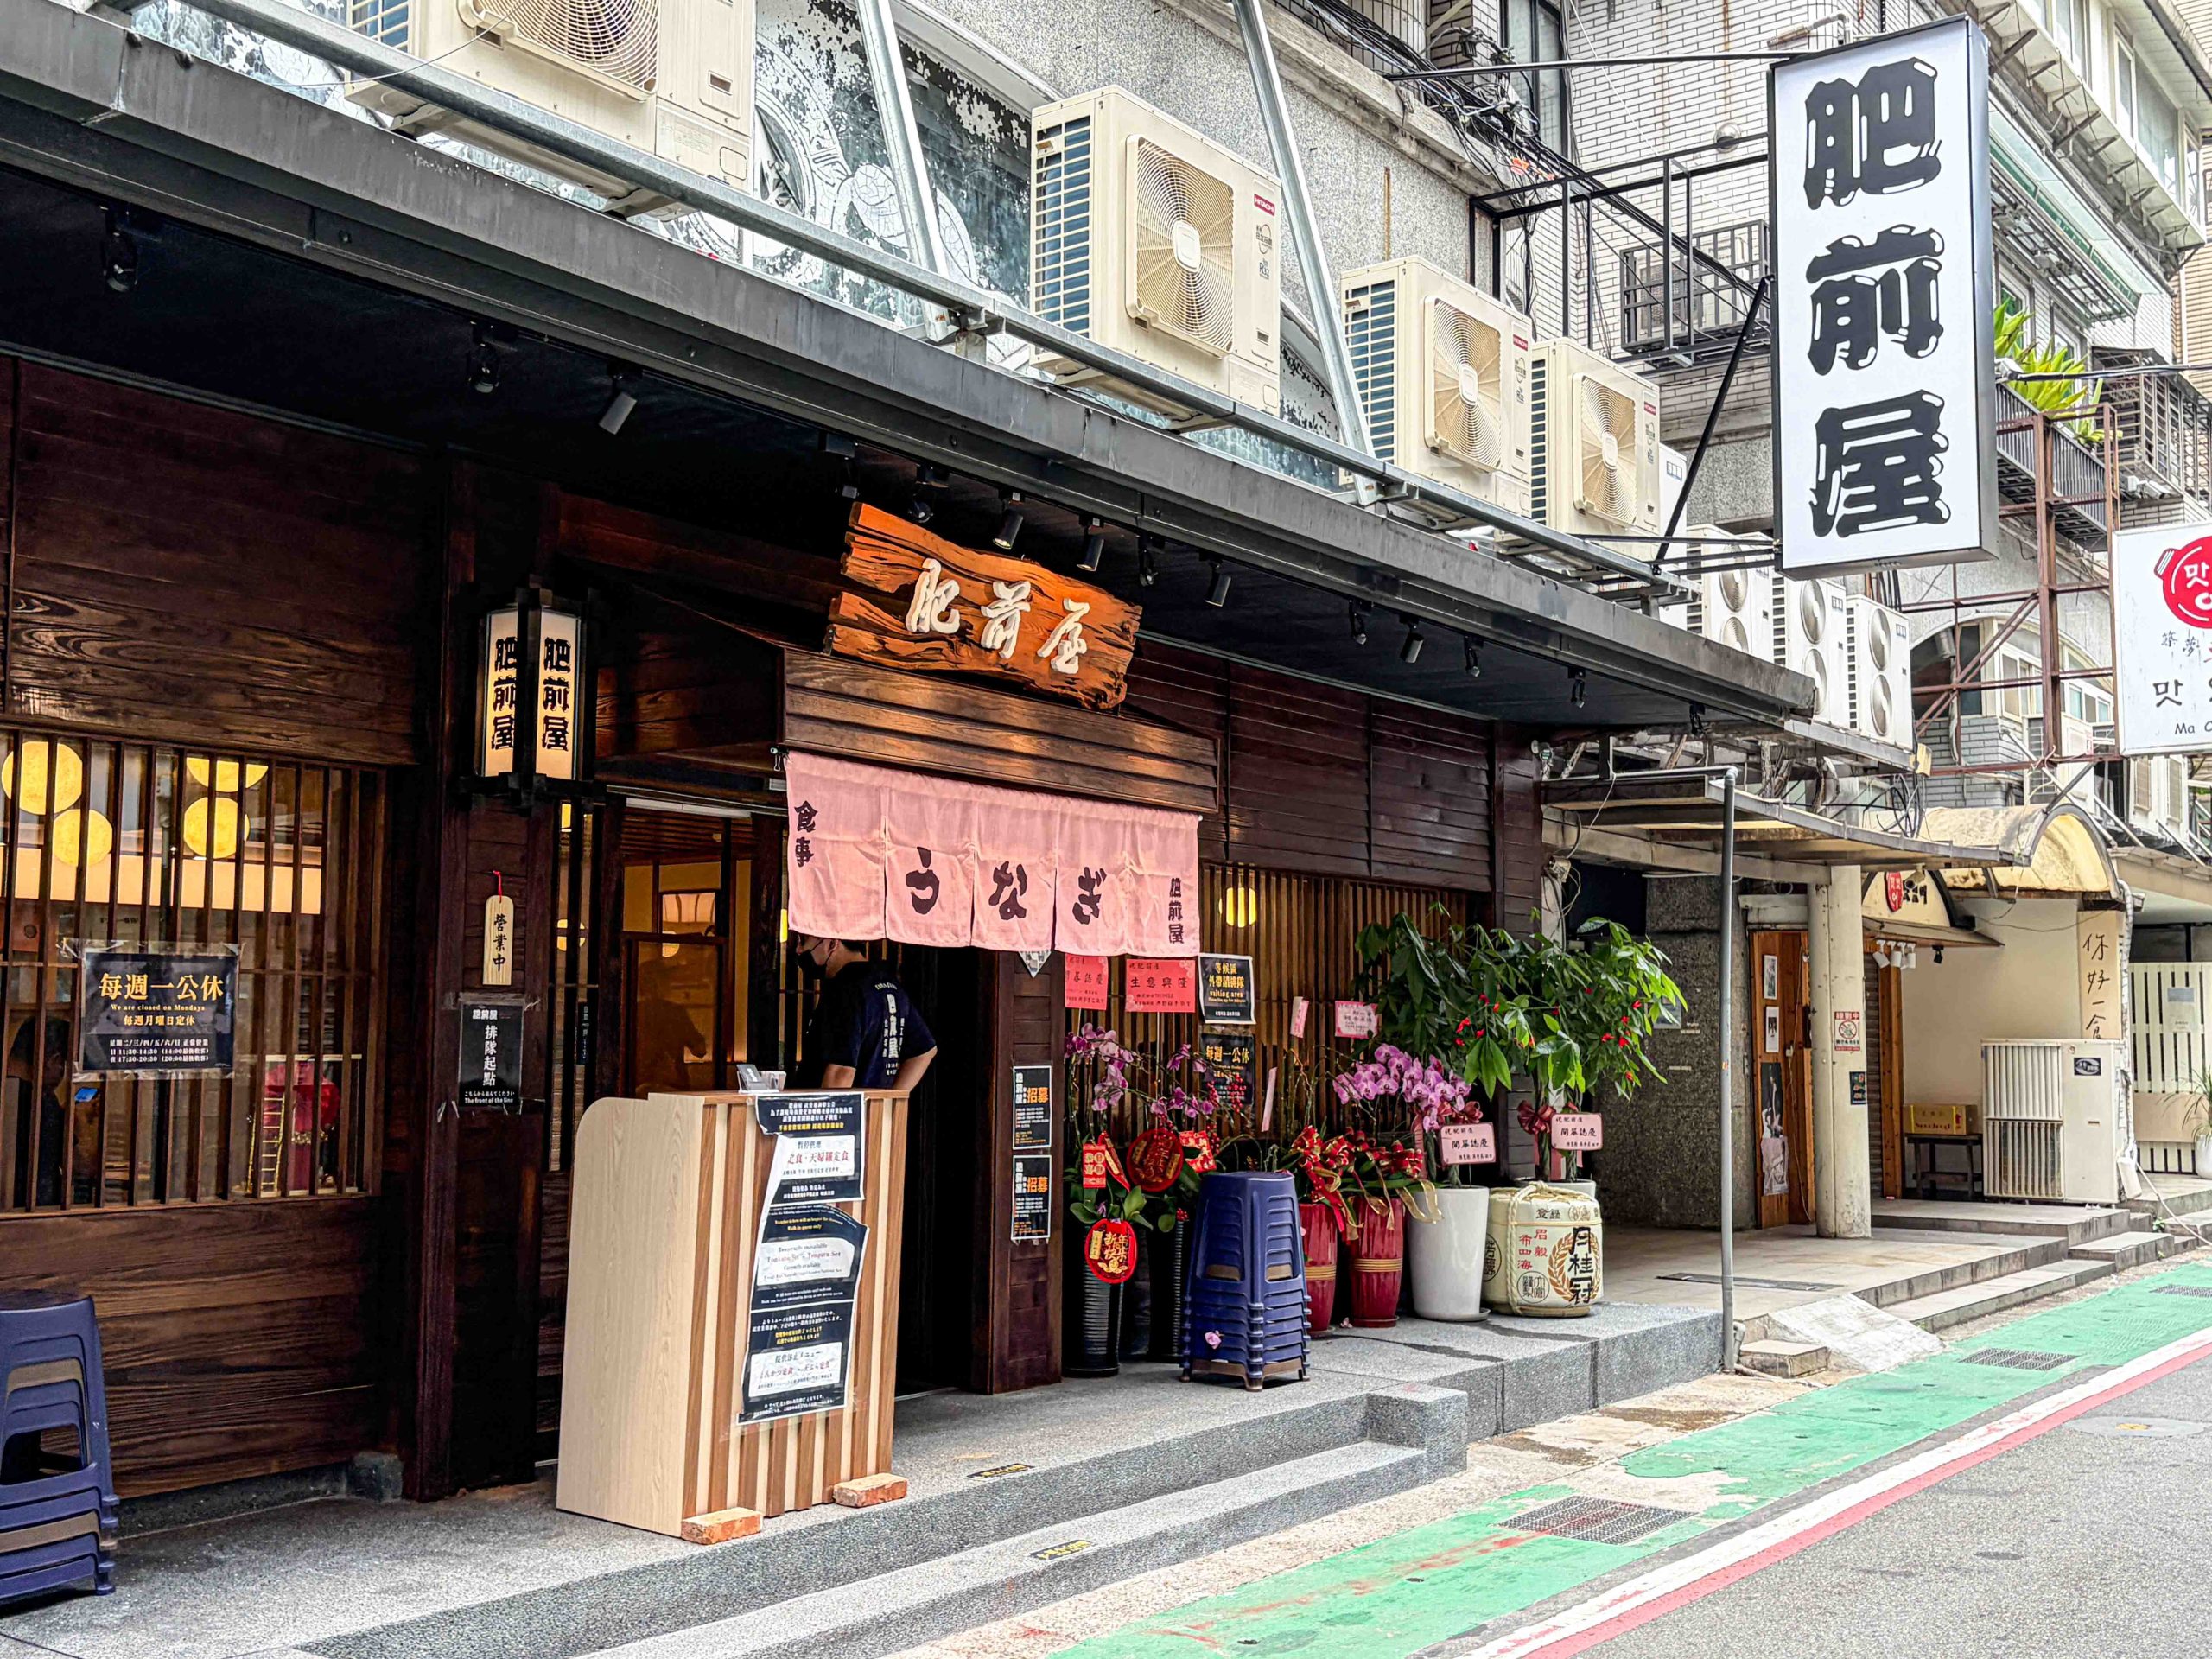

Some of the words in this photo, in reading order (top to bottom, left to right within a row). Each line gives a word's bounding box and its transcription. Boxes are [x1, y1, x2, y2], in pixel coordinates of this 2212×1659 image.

[1805, 56, 1950, 539] 肥前屋
[906, 557, 1090, 674] 肥前屋
[542, 637, 571, 751] 肥前屋
[2152, 679, 2183, 708] 맛
[2175, 721, 2196, 734] Ma
[794, 801, 817, 868] 食事
[493, 913, 507, 972] 營業中
[1167, 877, 1184, 944] 肥前屋
[99, 973, 224, 1001] 每週一公休
[1130, 976, 1188, 988] 生意興隆
[482, 1025, 498, 1087] 排隊起點
[1568, 1226, 1594, 1305] 月桂冠
